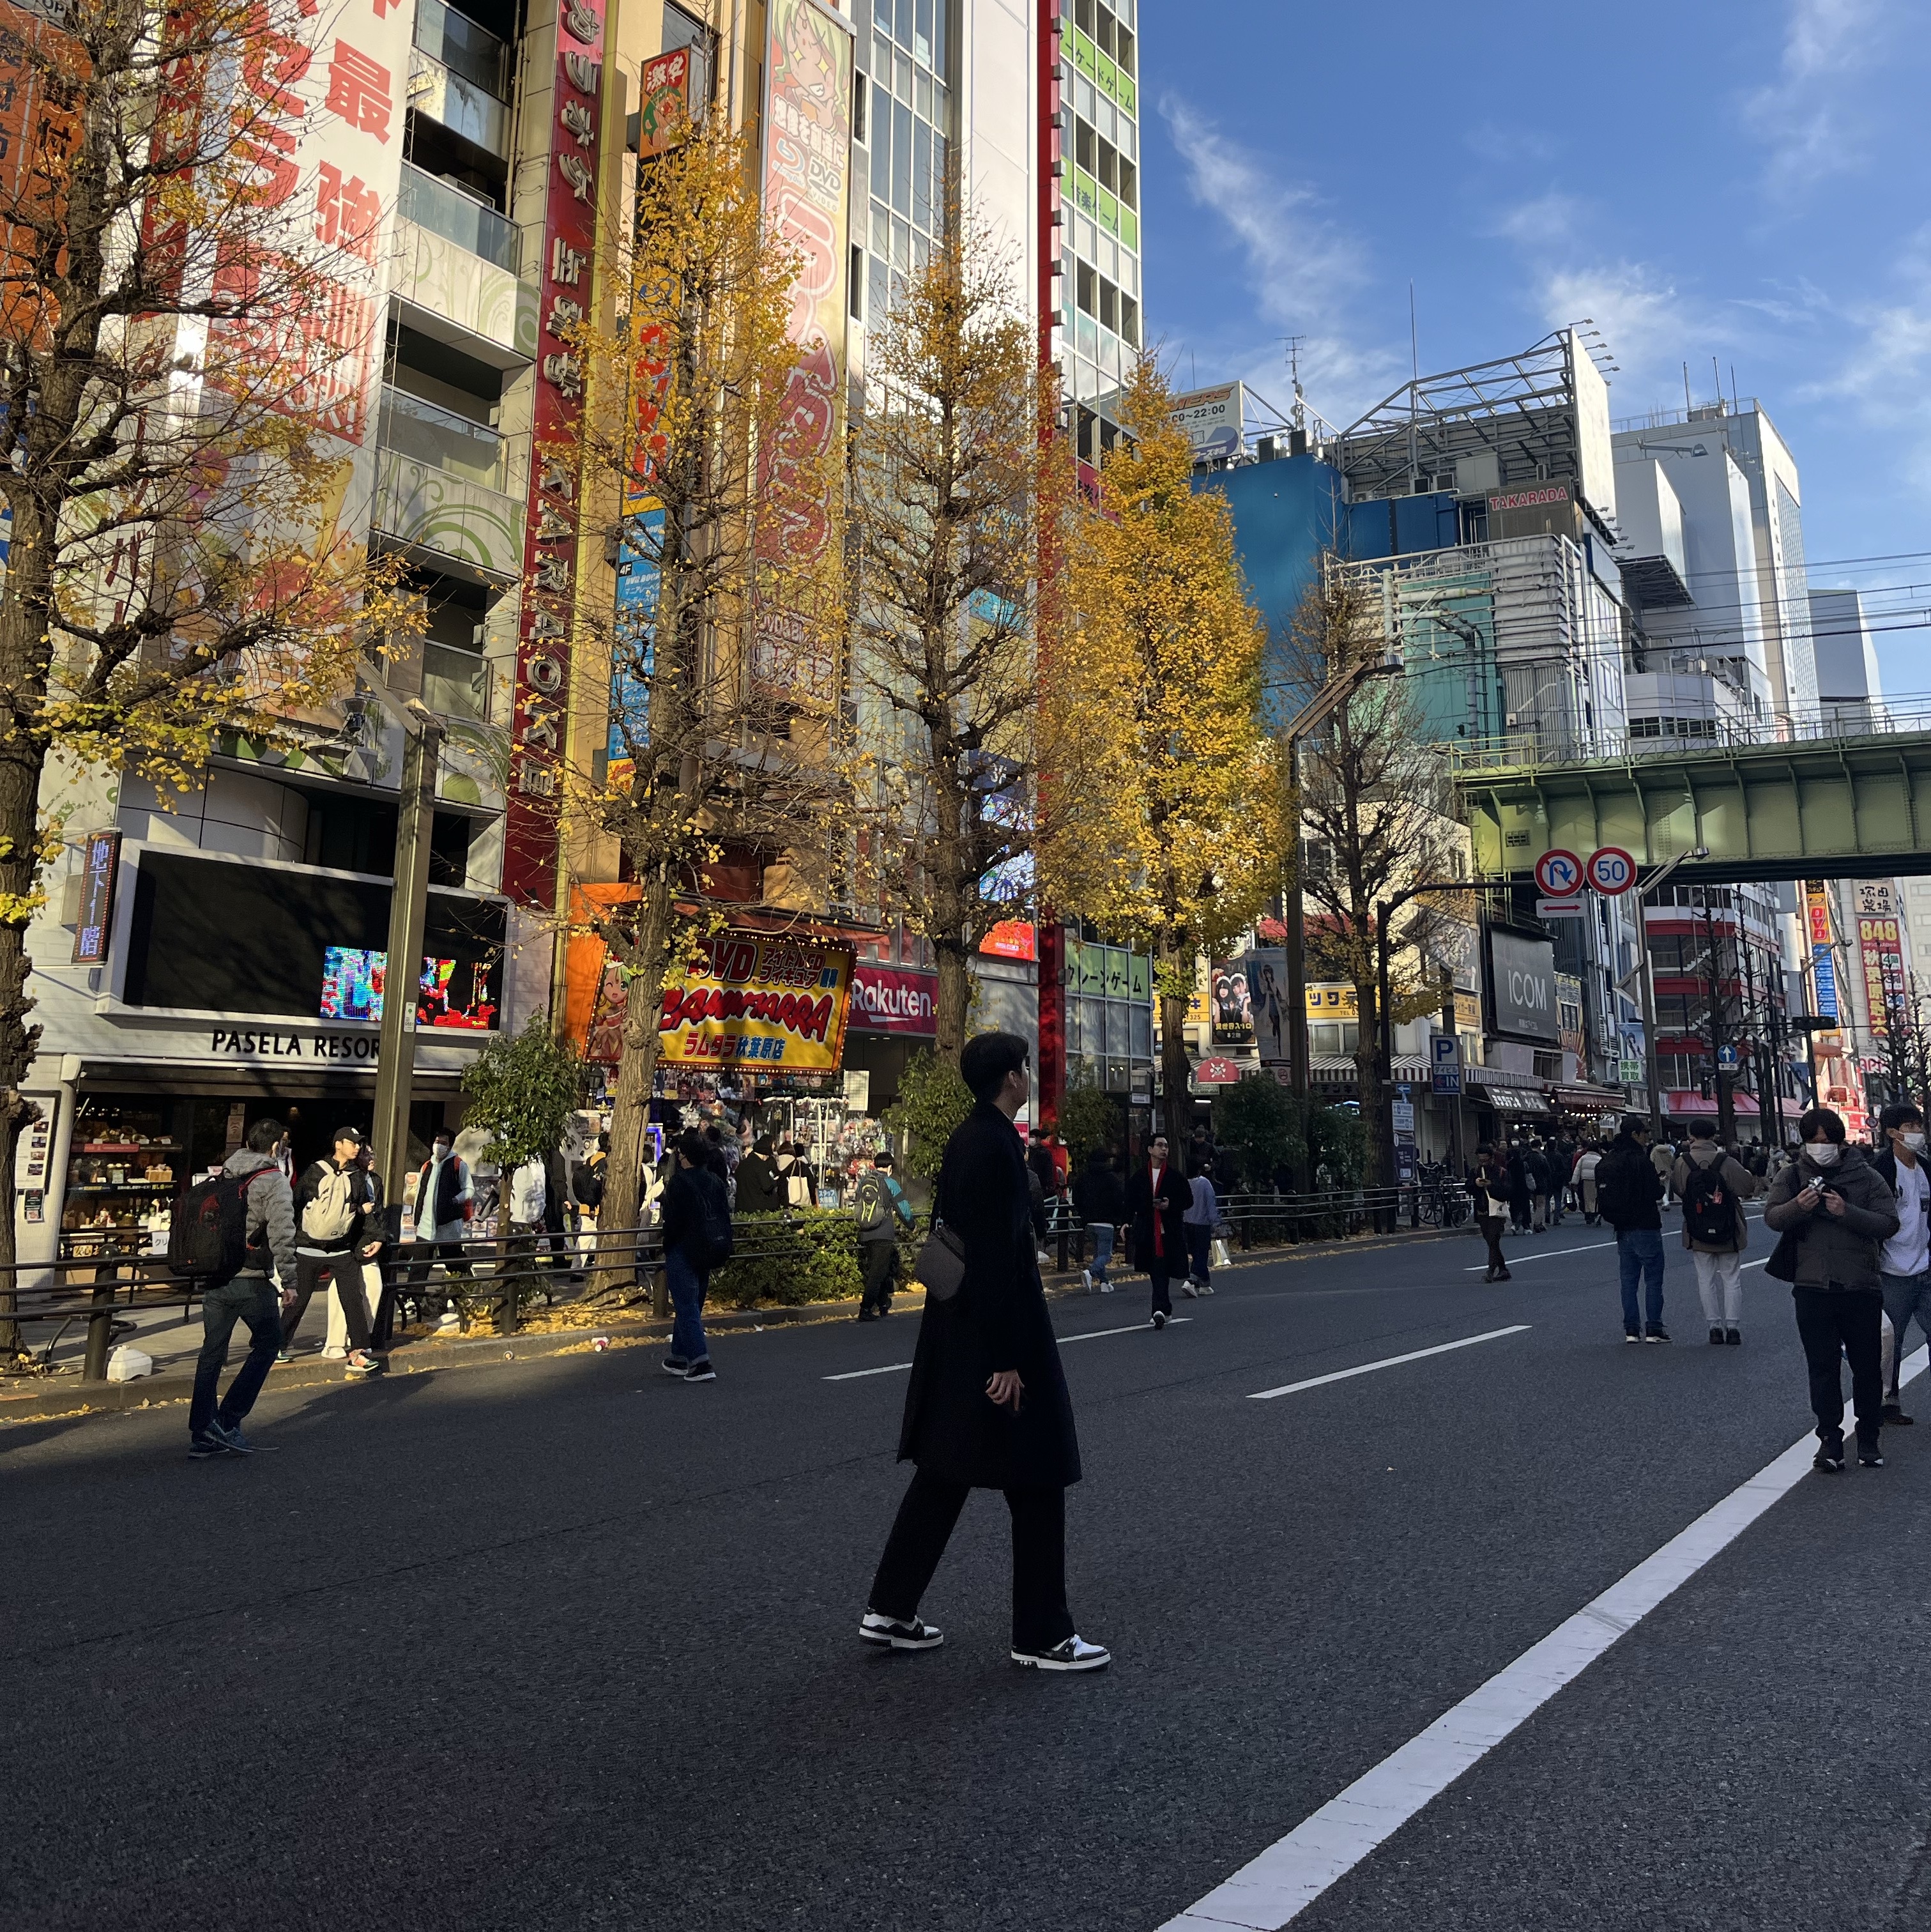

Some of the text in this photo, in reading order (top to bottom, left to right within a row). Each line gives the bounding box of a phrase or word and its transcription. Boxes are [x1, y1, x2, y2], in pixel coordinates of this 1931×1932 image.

[646, 55, 684, 91] 激安
[228, 0, 318, 208] セラ
[314, 0, 400, 269] 最強
[811, 160, 841, 190] DVD
[811, 190, 838, 212] VIDEO
[1166, 386, 1235, 412] MERS
[1489, 486, 1568, 511] TAKARADA
[620, 563, 632, 576] 4F
[1598, 860, 1624, 882] 50
[1811, 907, 1828, 940] DVD
[1859, 920, 1898, 941] 848
[851, 978, 931, 1017] Rakuten
[1508, 969, 1546, 1010] ICOM
[211, 1029, 379, 1059] PASELA RESOR
[683, 1031, 786, 1061] ラムタラ秋葉原店
[1436, 1039, 1453, 1062] P
[1433, 1066, 1458, 1075] ダイビル
[1620, 1061, 1640, 1071] 携帯
[1621, 1071, 1640, 1081] 買取
[1446, 1076, 1460, 1087] IN
